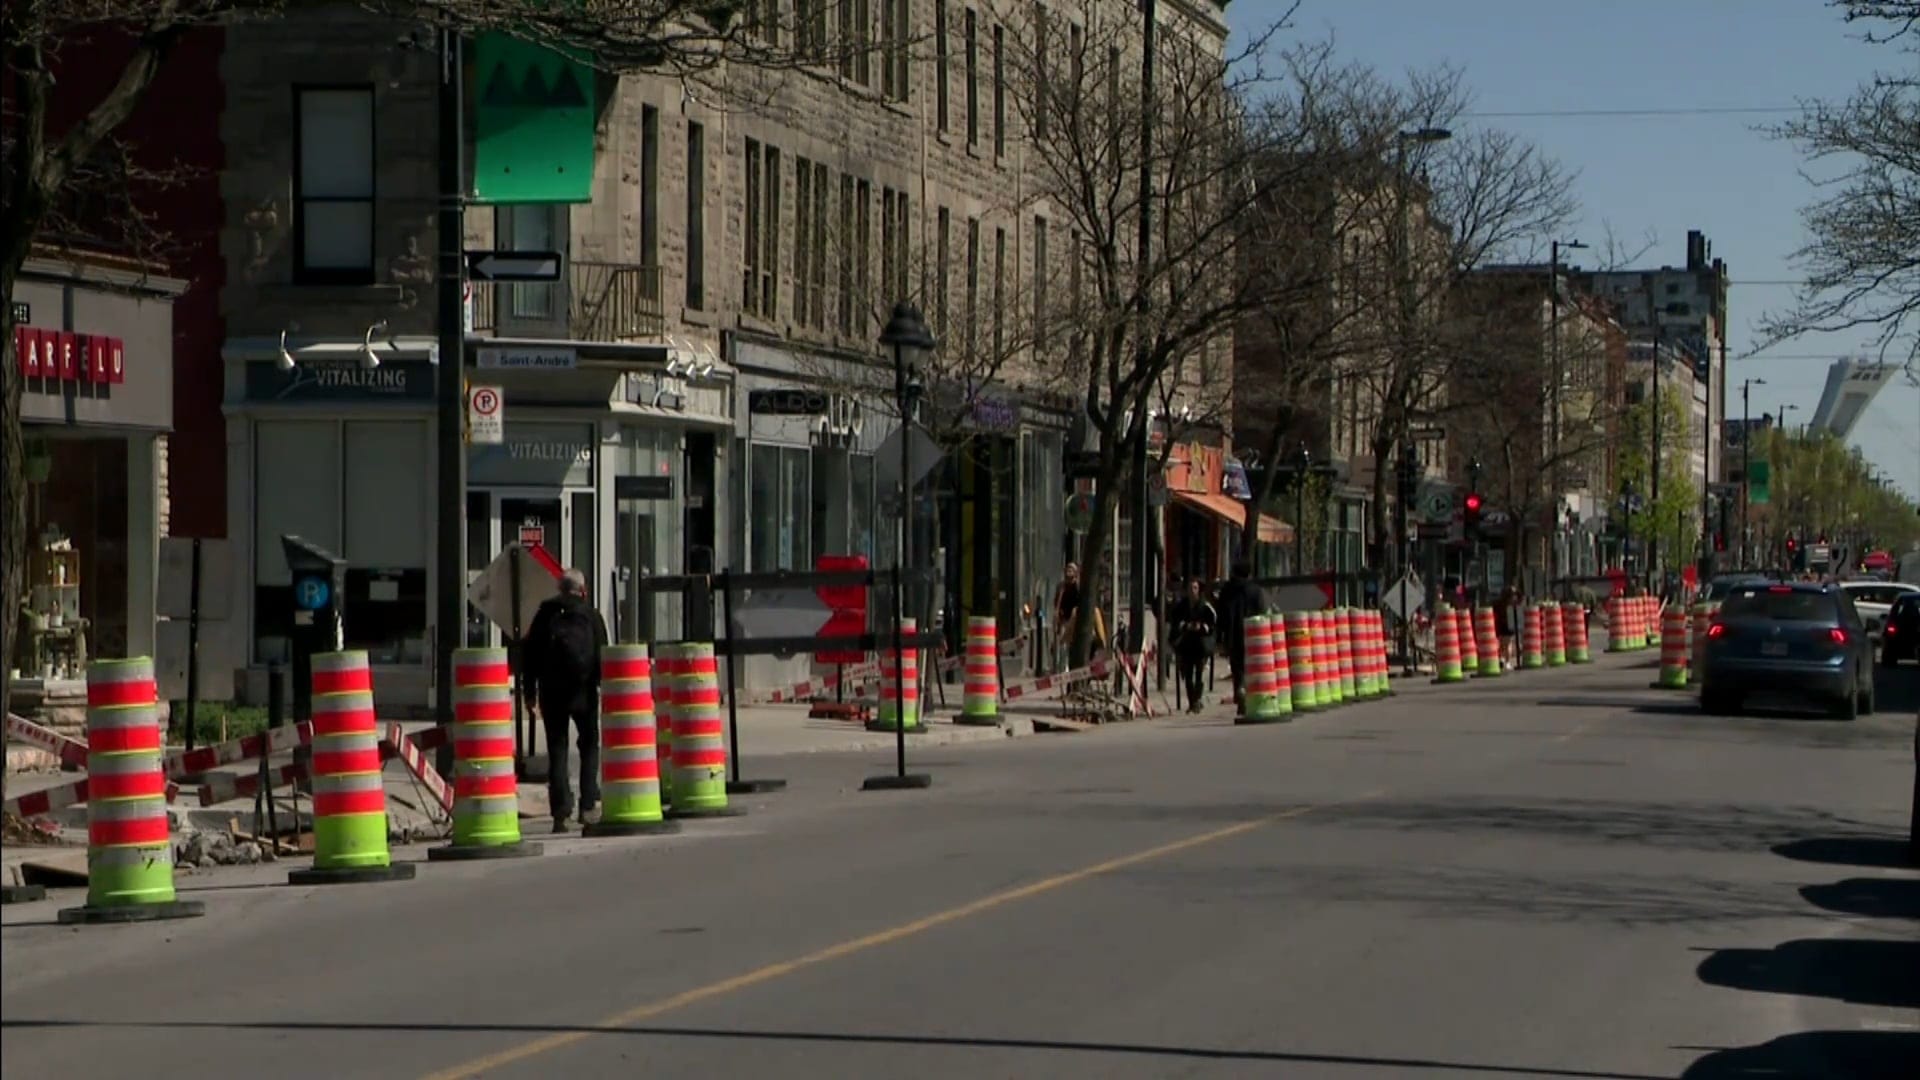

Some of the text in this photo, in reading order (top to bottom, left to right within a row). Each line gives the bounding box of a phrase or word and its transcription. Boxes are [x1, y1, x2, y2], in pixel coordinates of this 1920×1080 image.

[14, 336, 122, 375] ARFELU
[500, 353, 570, 366] Saint-André
[316, 368, 406, 387] VITALIZING
[757, 393, 824, 411] ALDO
[509, 442, 591, 460] VITALIZING
